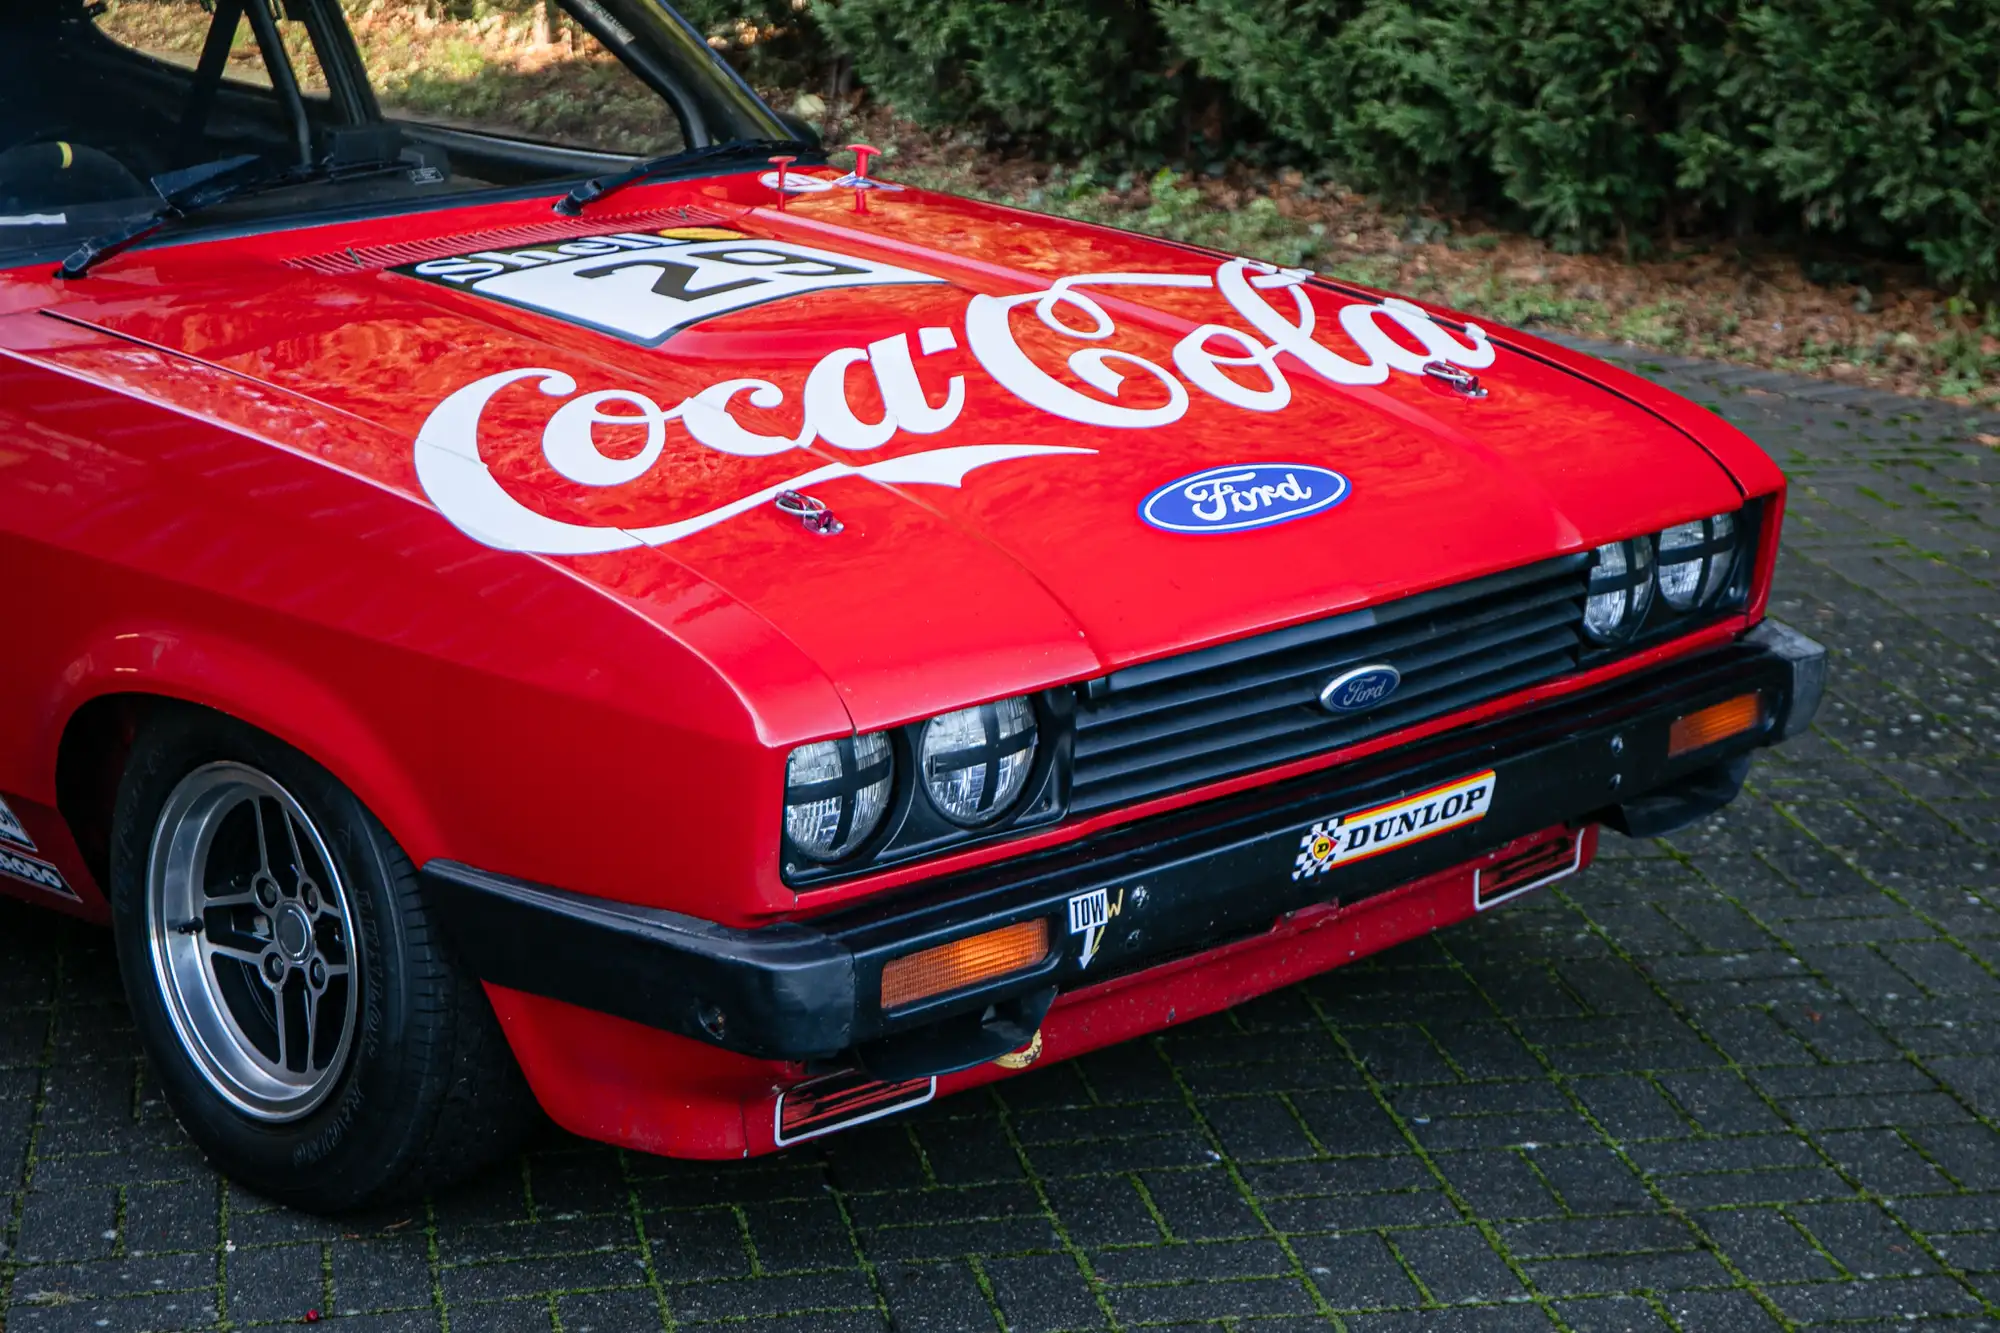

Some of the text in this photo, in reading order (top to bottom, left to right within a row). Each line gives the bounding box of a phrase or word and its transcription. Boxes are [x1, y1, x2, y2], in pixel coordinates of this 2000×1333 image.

[415, 231, 690, 285] Shell
[572, 248, 874, 302] 29
[1184, 471, 1313, 521] Ford
[1342, 675, 1388, 706] Ford
[1344, 785, 1487, 853] DUNLOP
[1072, 893, 1105, 930] TOW
